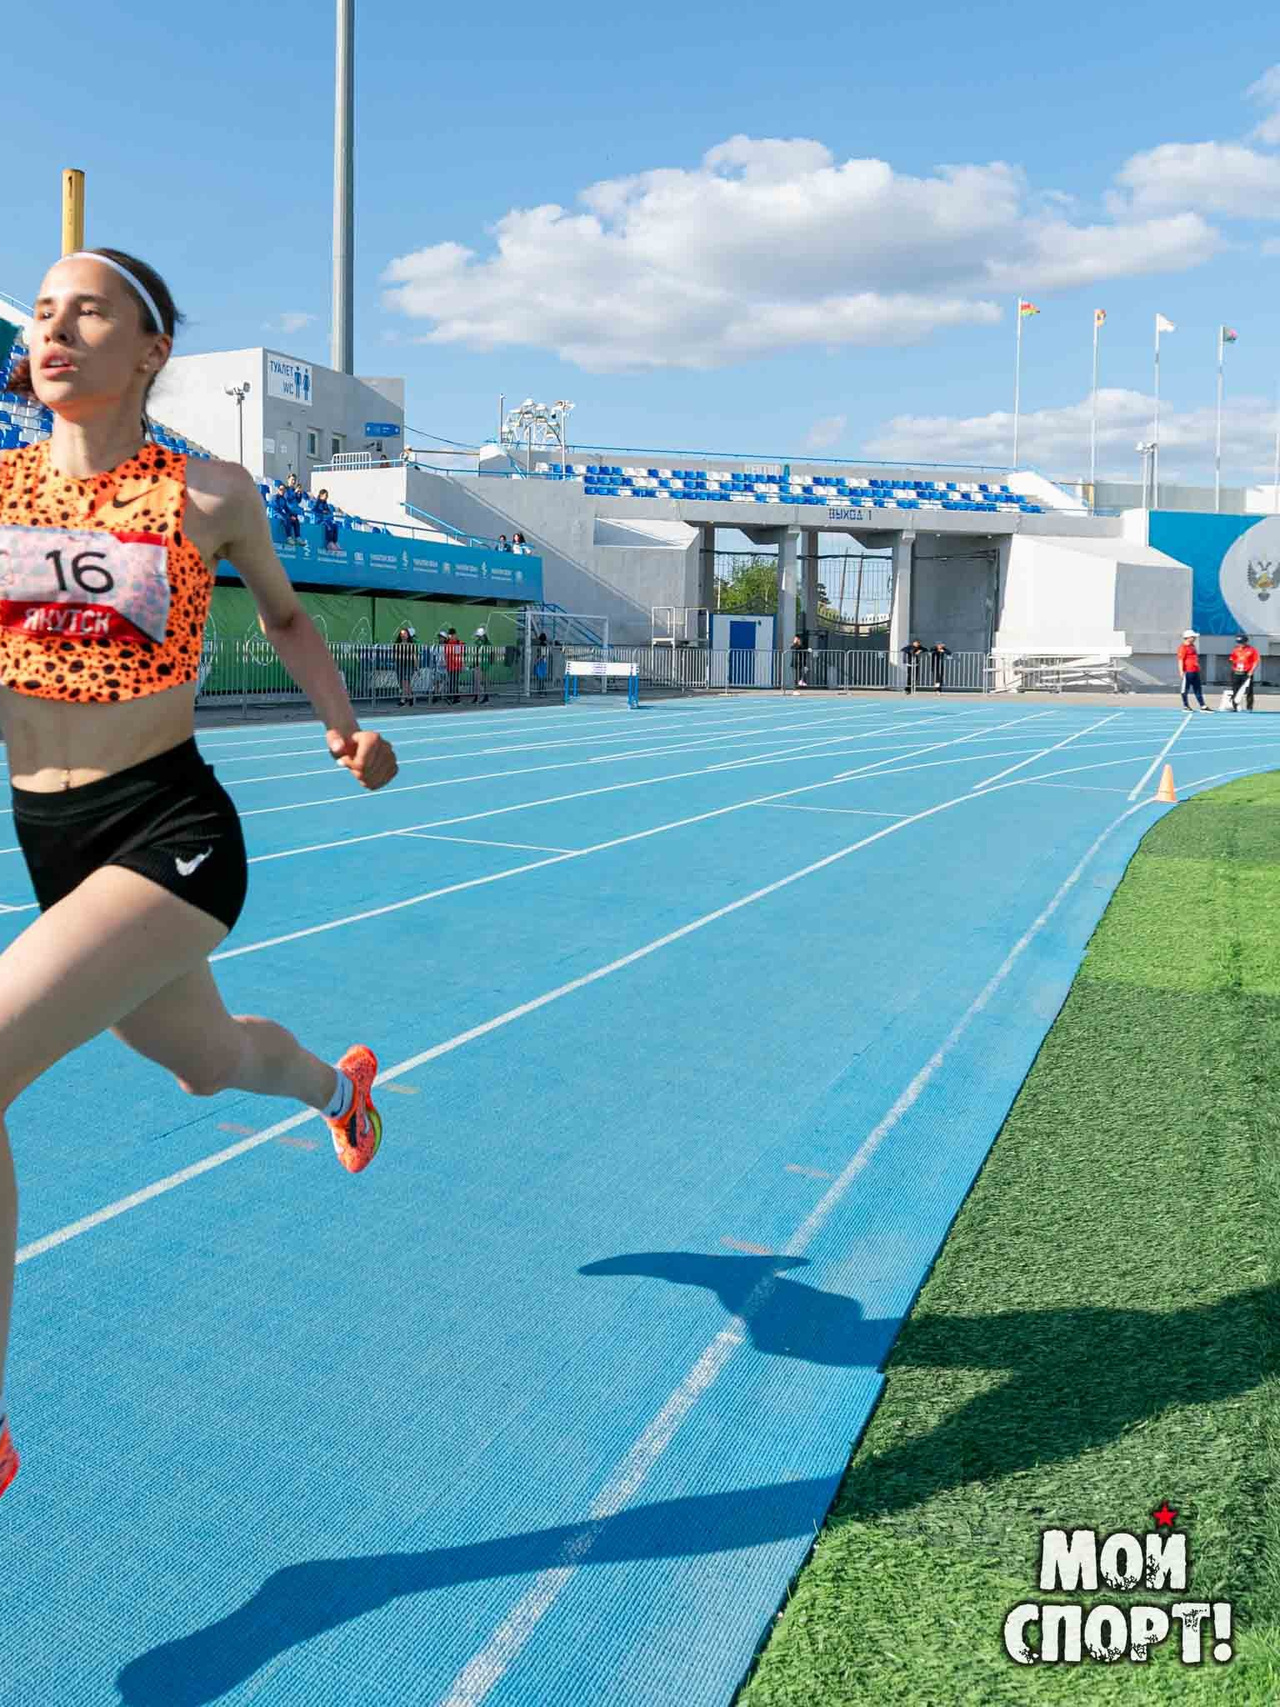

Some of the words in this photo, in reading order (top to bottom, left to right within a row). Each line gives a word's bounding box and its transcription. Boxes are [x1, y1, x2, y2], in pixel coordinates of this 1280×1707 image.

[270, 360, 294, 376] ТУАЛЕТ
[282, 380, 294, 394] WC
[829, 508, 863, 520] ВЫХОД
[45, 549, 114, 594] 16
